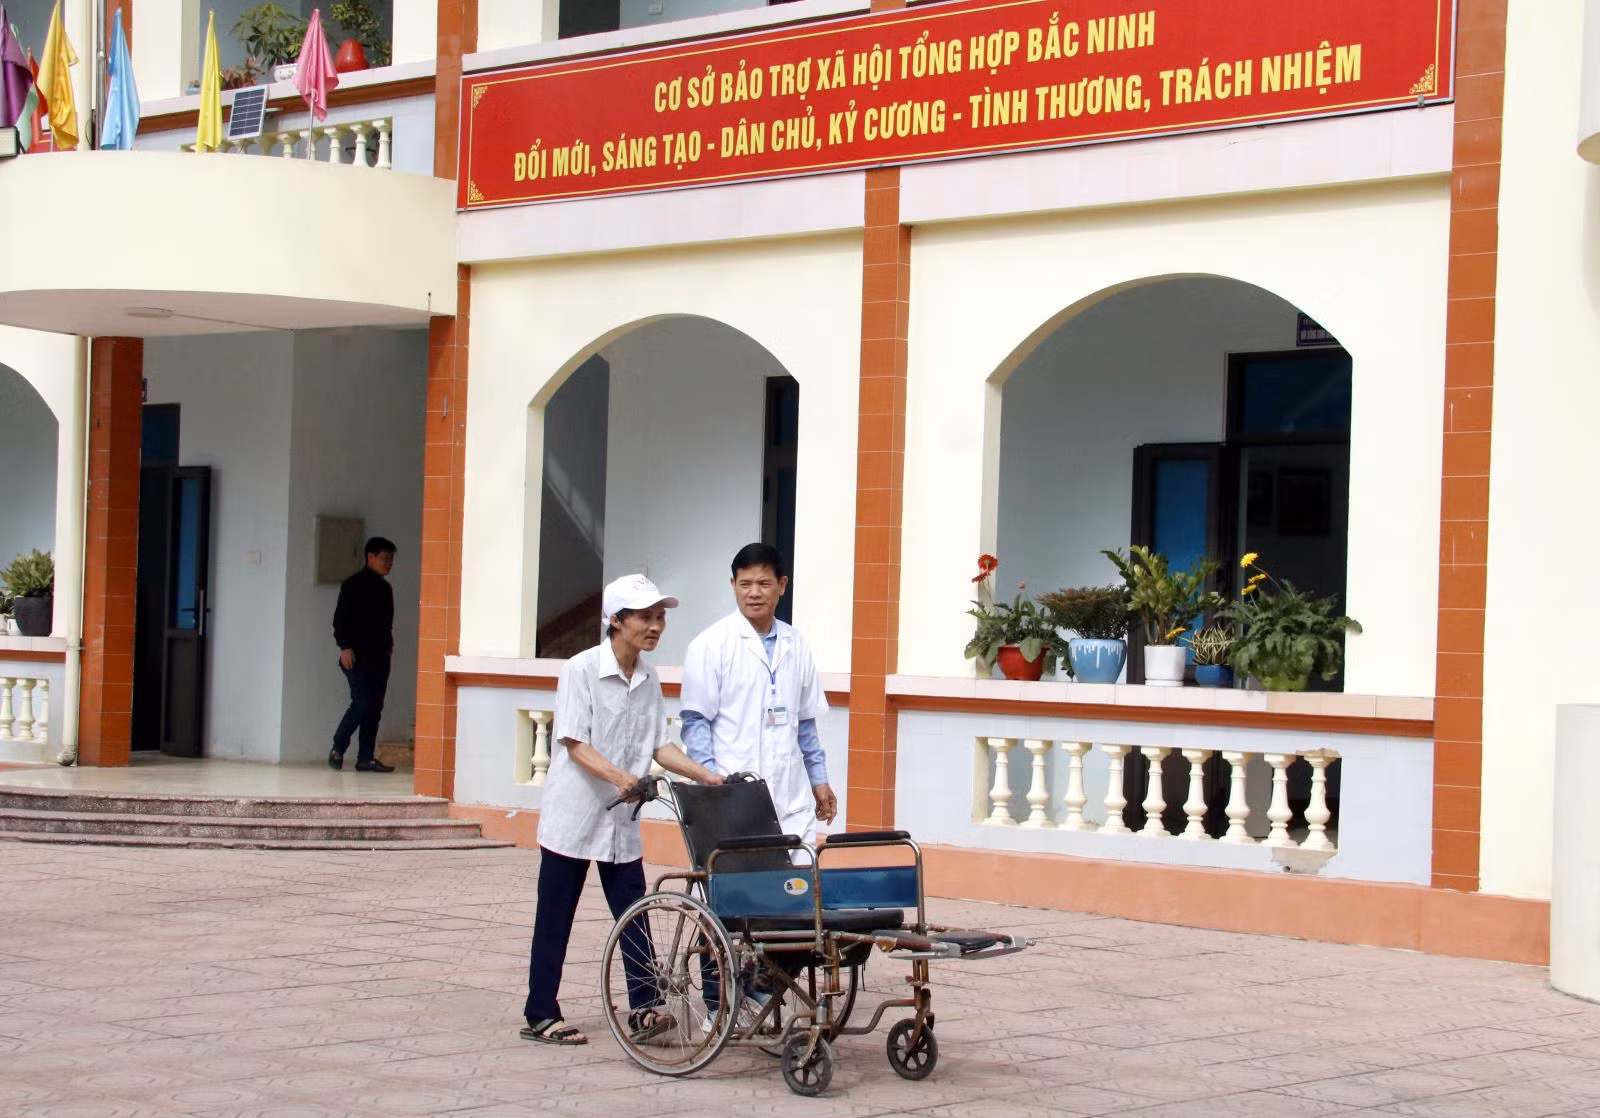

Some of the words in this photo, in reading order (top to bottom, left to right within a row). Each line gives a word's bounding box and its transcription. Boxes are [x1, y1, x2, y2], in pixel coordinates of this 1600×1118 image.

[513, 138, 547, 182] ĐỔI
[552, 139, 597, 180] MỚI,
[602, 133, 657, 173] SÁNG
[662, 132, 701, 171] TẠO
[707, 143, 715, 151] -
[720, 117, 765, 161] DÂN
[771, 105, 822, 154] CHỦ,
[828, 99, 858, 145] KỶ
[863, 99, 946, 141] CƯƠNG
[952, 112, 962, 121] -
[969, 86, 1028, 129] TÌNH
[1035, 74, 1151, 121] THƯƠNG,
[1159, 57, 1253, 106] TRÁCH
[1260, 40, 1362, 95] NHIỆM
[654, 77, 683, 113] CƠ
[687, 64, 716, 109] SỞ
[720, 60, 763, 104] BẢO
[769, 57, 812, 101] TRỢ
[815, 49, 847, 91] XÃ
[852, 44, 892, 91] HỘI
[898, 30, 963, 80] TỔNG
[969, 27, 1020, 75] HỢP
[1027, 11, 1080, 63] BẮC
[1087, 10, 1156, 55] NINH
